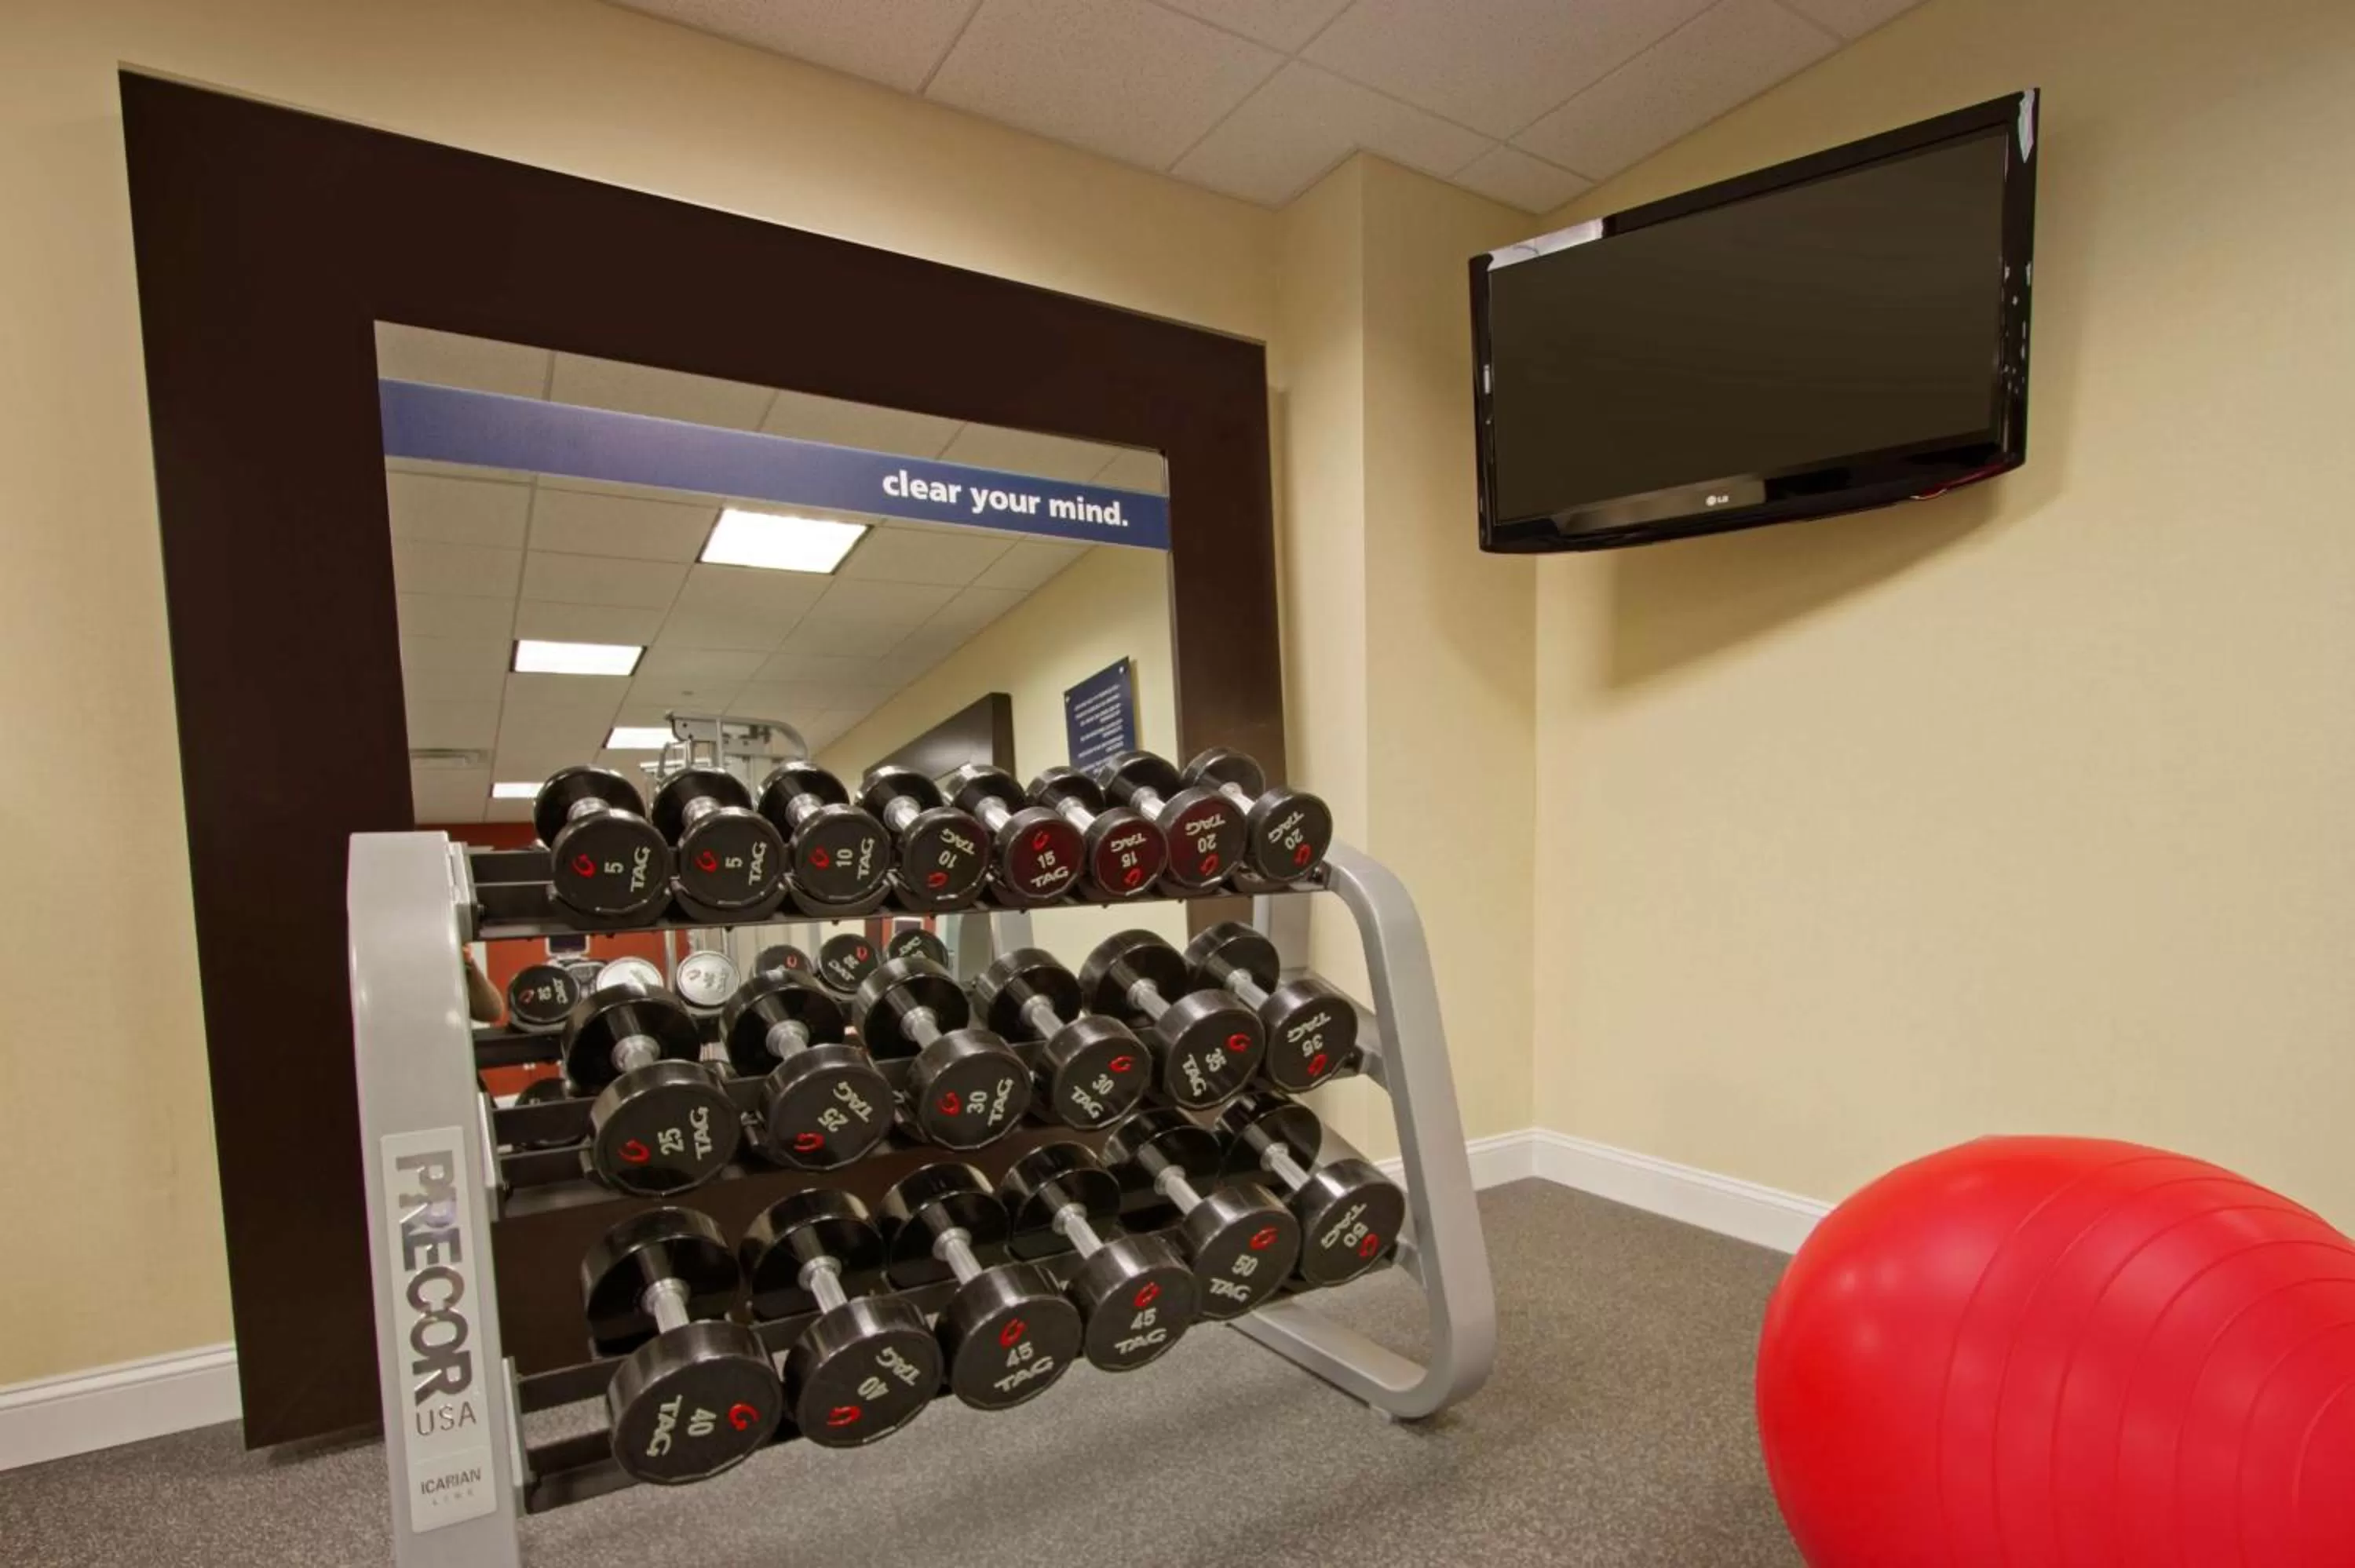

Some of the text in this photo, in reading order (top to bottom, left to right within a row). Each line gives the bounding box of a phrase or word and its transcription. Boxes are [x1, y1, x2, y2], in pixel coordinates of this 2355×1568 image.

[882, 469, 1129, 527] clear your mind.
[1185, 814, 1225, 836] TAG
[1268, 810, 1304, 844] TAG
[940, 829, 975, 855] TAG
[1109, 833, 1147, 852] TAG
[1196, 833, 1218, 853] 20
[1285, 828, 1304, 851] 20
[604, 862, 623, 873] 5
[630, 846, 651, 892] TAG
[725, 857, 743, 868] 5
[748, 841, 767, 885] TAG
[836, 848, 853, 867] 10
[857, 838, 874, 879] TAG
[938, 851, 958, 869] 10
[1037, 851, 1056, 869] 15
[1120, 851, 1137, 867] 15
[1031, 866, 1069, 888] TAG
[1287, 1012, 1331, 1043] TAG
[1302, 1033, 1323, 1057] 35
[1205, 1048, 1226, 1072] 35
[1092, 1074, 1114, 1096] 30
[1182, 1053, 1208, 1096] TAG
[832, 1081, 874, 1122] TAG
[966, 1091, 988, 1114] 30
[988, 1078, 1014, 1126] TAG
[1071, 1085, 1104, 1120] TAG
[817, 1106, 850, 1132] 25
[657, 1128, 684, 1155] 25
[689, 1107, 712, 1160] TAG
[1321, 1202, 1367, 1249] TAG
[1343, 1223, 1370, 1247] 50
[395, 1150, 473, 1407] PRECOR
[1231, 1255, 1259, 1276] 50
[1210, 1277, 1251, 1302] TAG
[1131, 1308, 1157, 1329] 45
[1006, 1341, 1034, 1367] 45
[1115, 1329, 1167, 1354] TAG
[875, 1347, 920, 1386] TAG
[994, 1356, 1055, 1394] TAG
[858, 1376, 889, 1401] 40
[414, 1401, 478, 1437] USA
[646, 1395, 683, 1457] TAG
[688, 1408, 714, 1436] 40
[420, 1467, 483, 1495] ICARIAN
